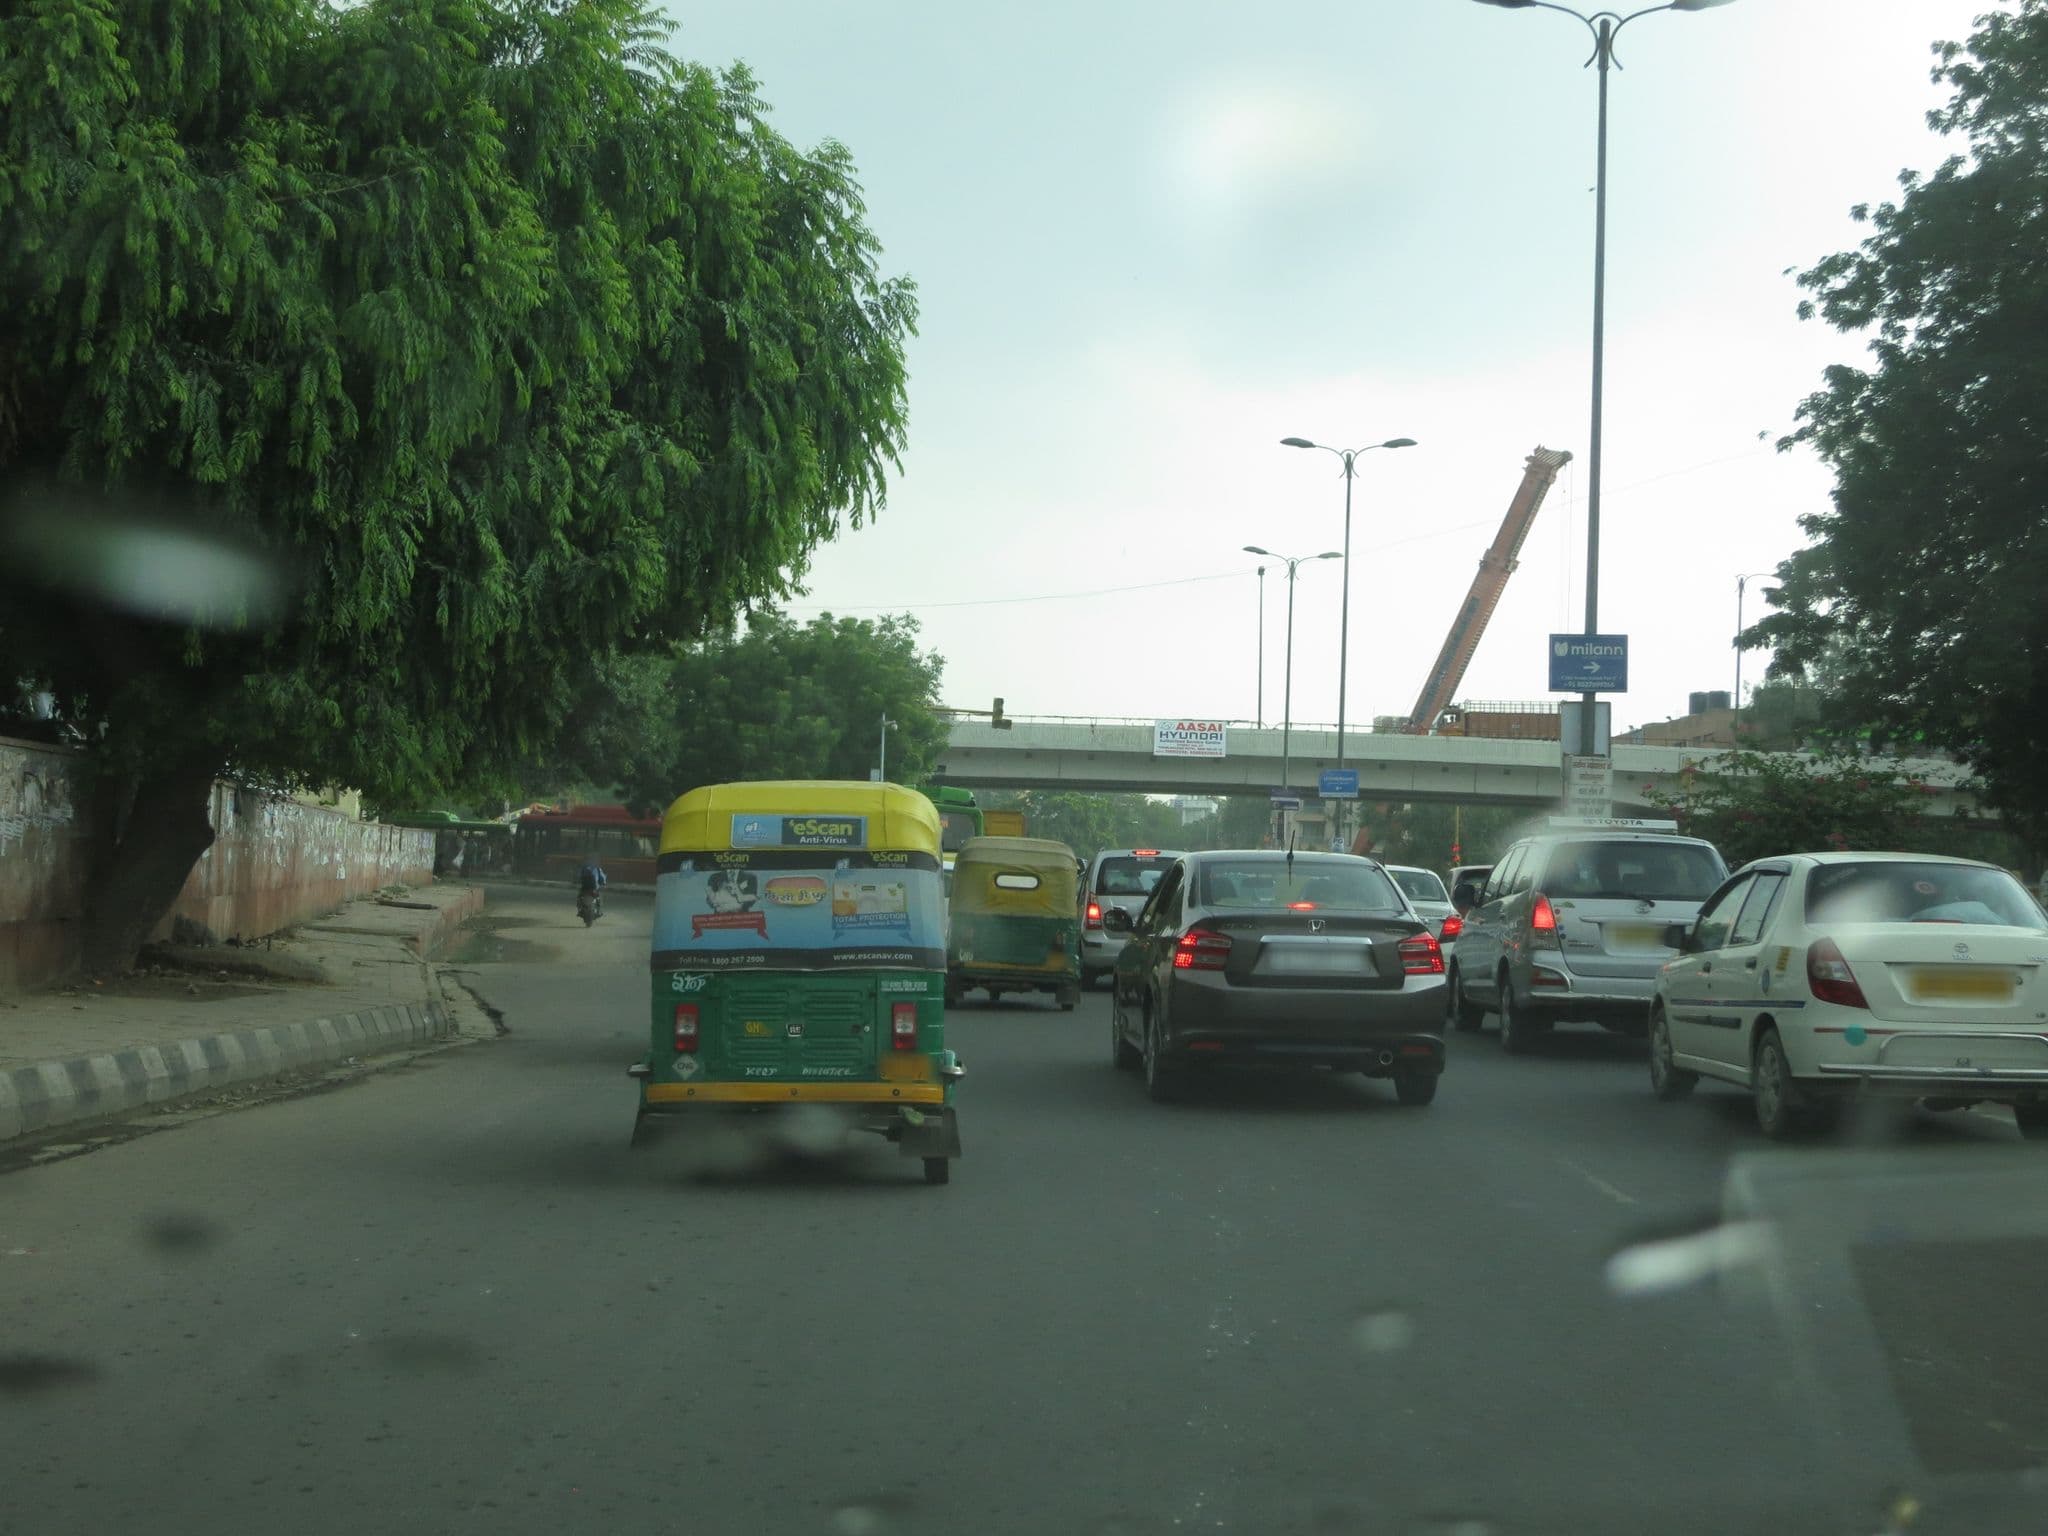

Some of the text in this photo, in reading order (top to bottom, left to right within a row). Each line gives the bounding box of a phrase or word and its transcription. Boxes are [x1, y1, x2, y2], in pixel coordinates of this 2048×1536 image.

[1571, 643, 1623, 656] milann
[1176, 722, 1222, 732] AASAI
[1160, 731, 1222, 741] HYUNDAI
[1599, 818, 1643, 826] TOYOTA
[793, 820, 852, 836] eScan
[800, 836, 847, 844] Anti-Virus
[716, 852, 749, 863] eScan
[873, 852, 908, 863] eScan
[859, 913, 906, 921] PROTECTION
[712, 957, 729, 965] 1800
[833, 952, 913, 960] www.escanav.com
